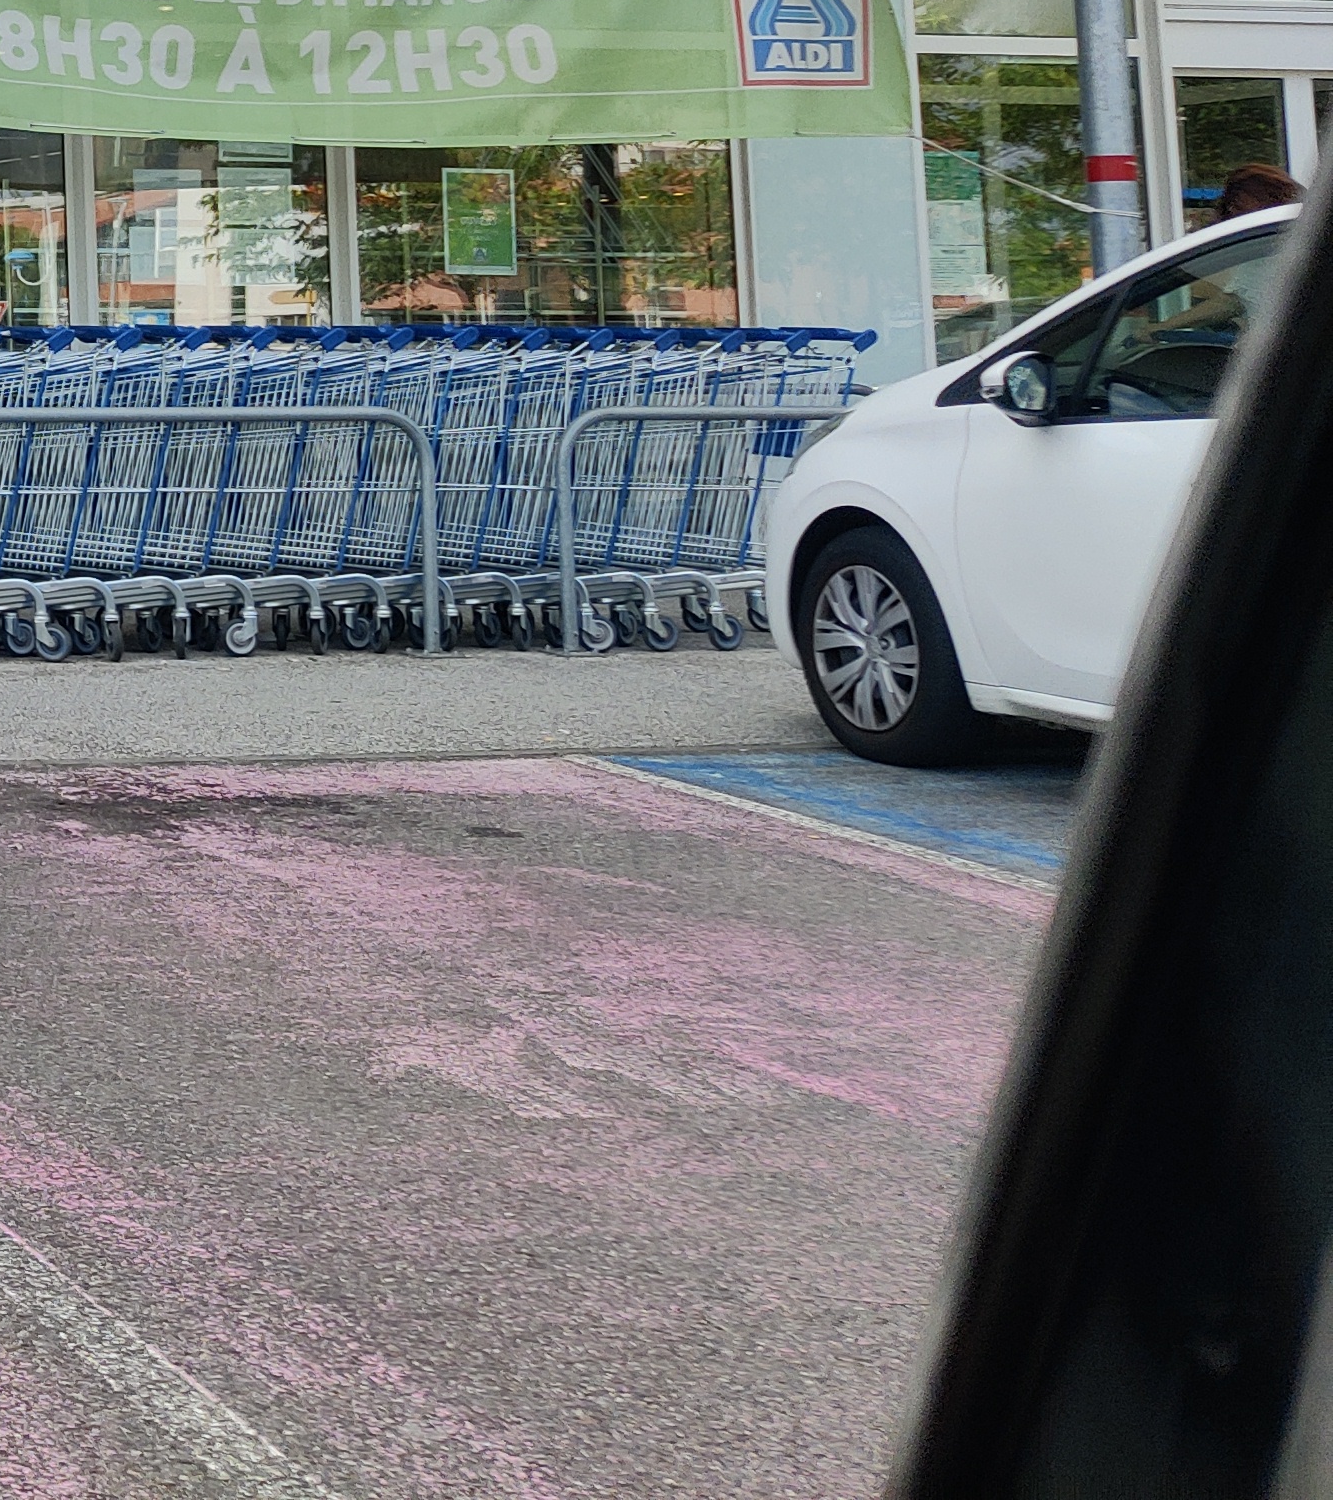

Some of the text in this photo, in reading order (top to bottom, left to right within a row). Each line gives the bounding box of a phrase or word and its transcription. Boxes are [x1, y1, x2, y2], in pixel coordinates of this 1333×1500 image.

[216, 5, 276, 94] À
[299, 23, 558, 95] 12H30
[764, 41, 844, 70] ALDI
